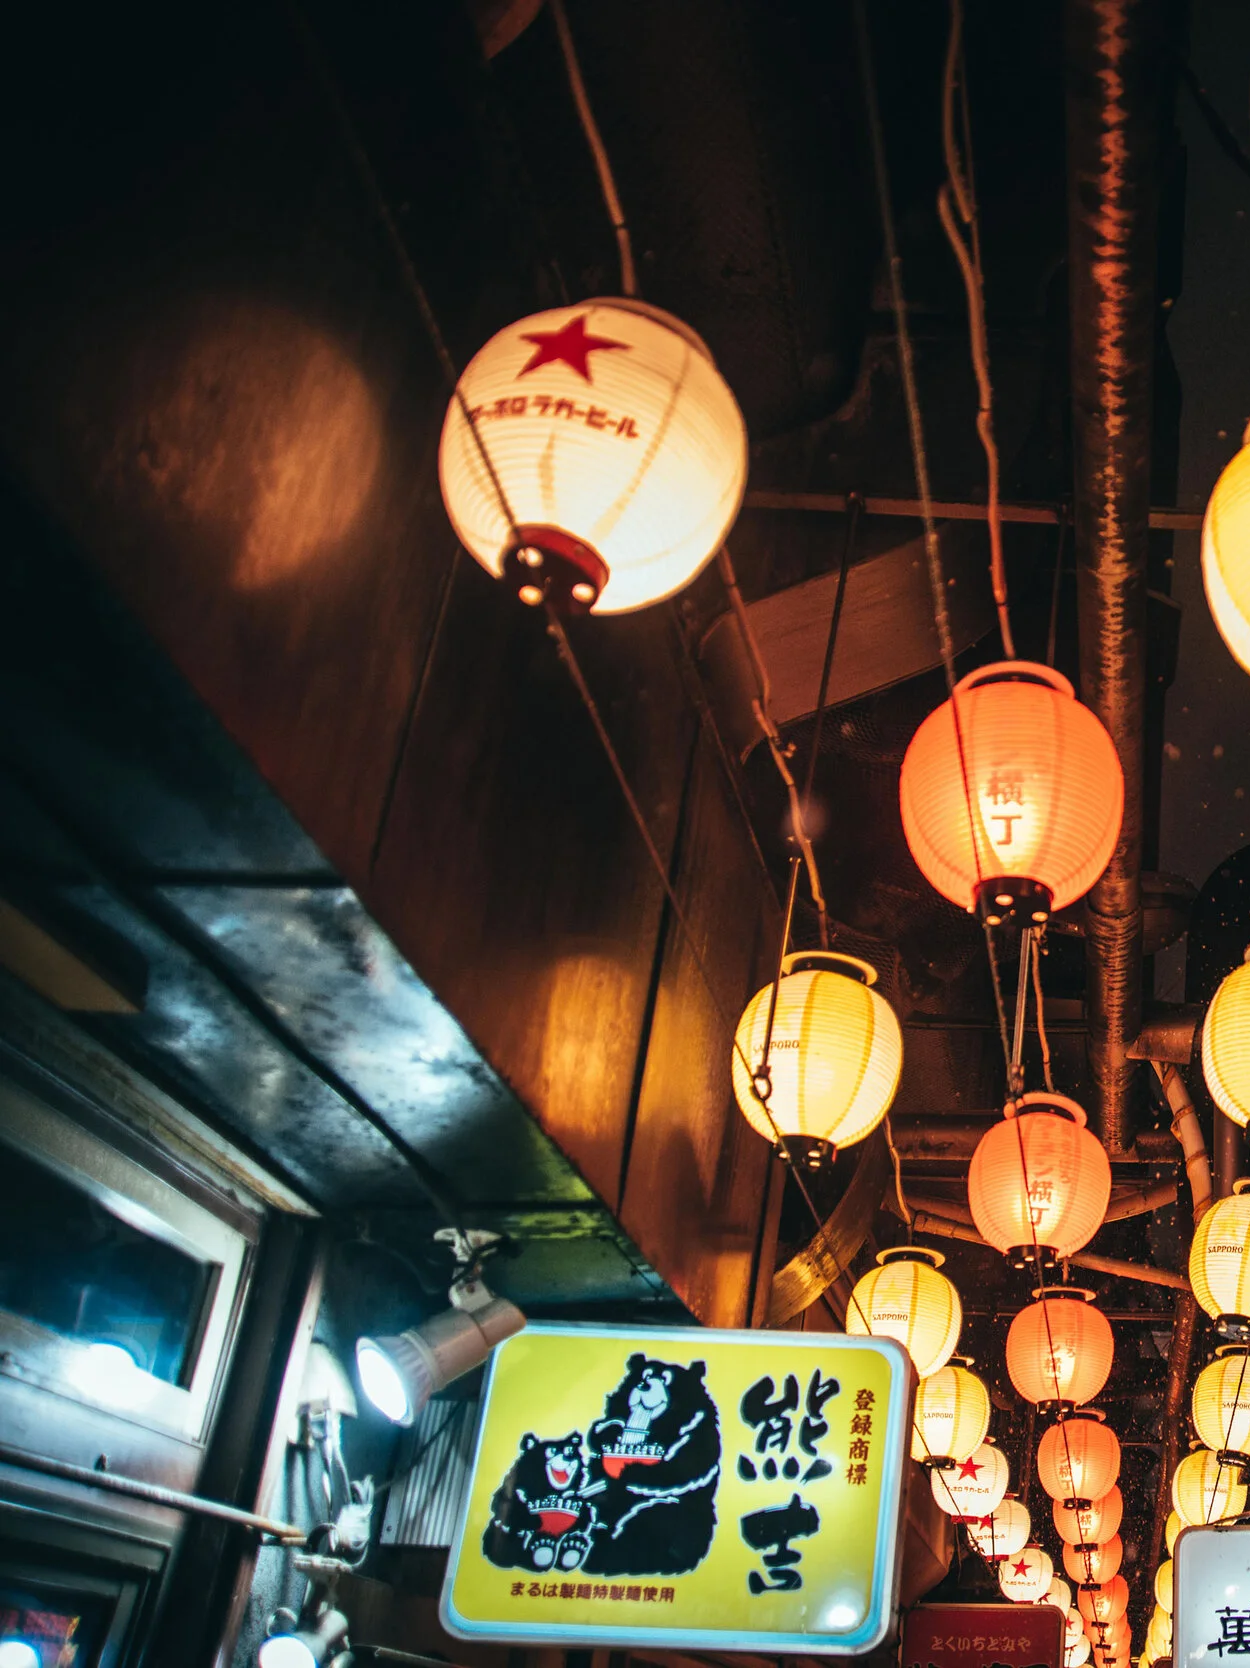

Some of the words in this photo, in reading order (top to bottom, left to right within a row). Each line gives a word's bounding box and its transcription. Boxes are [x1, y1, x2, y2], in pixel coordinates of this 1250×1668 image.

[1207, 1245, 1244, 1254] SAPPORO
[872, 1313, 908, 1322] SAPPORO
[845, 1388, 876, 1486] 登録商標
[737, 1368, 841, 1596] 熊吉
